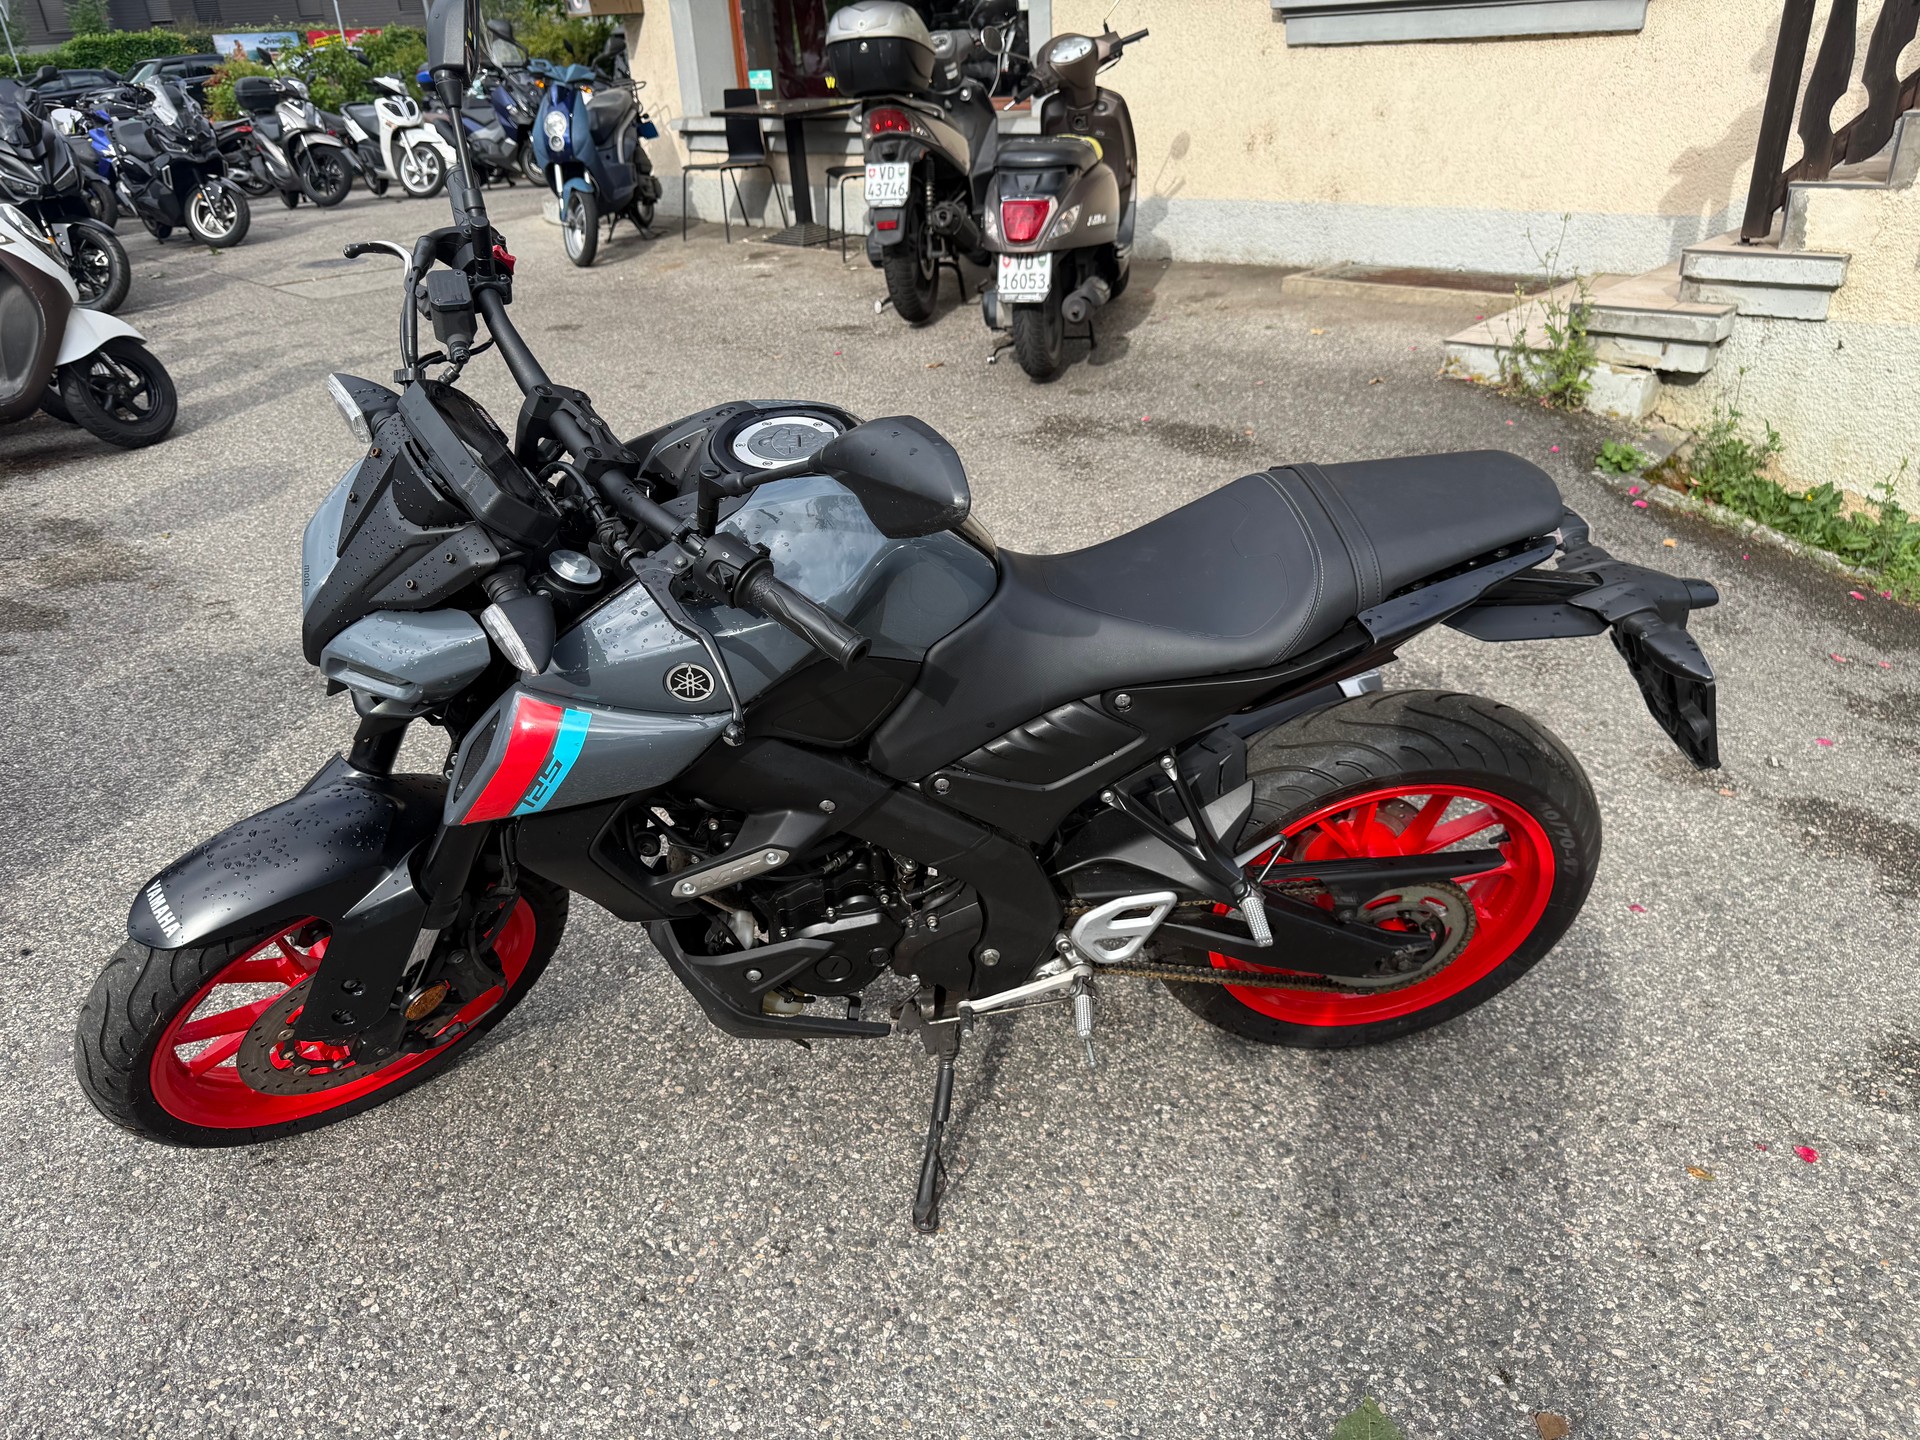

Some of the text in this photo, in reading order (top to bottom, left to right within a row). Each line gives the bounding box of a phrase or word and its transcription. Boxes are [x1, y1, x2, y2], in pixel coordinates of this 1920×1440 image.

[879, 167, 895, 179] VD
[867, 182, 905, 197] 43746
[1016, 253, 1034, 270] VD
[1002, 273, 1046, 290] 16053
[303, 564, 311, 587] moto
[700, 859, 761, 890] MT
[146, 879, 181, 939] YAMAHA
